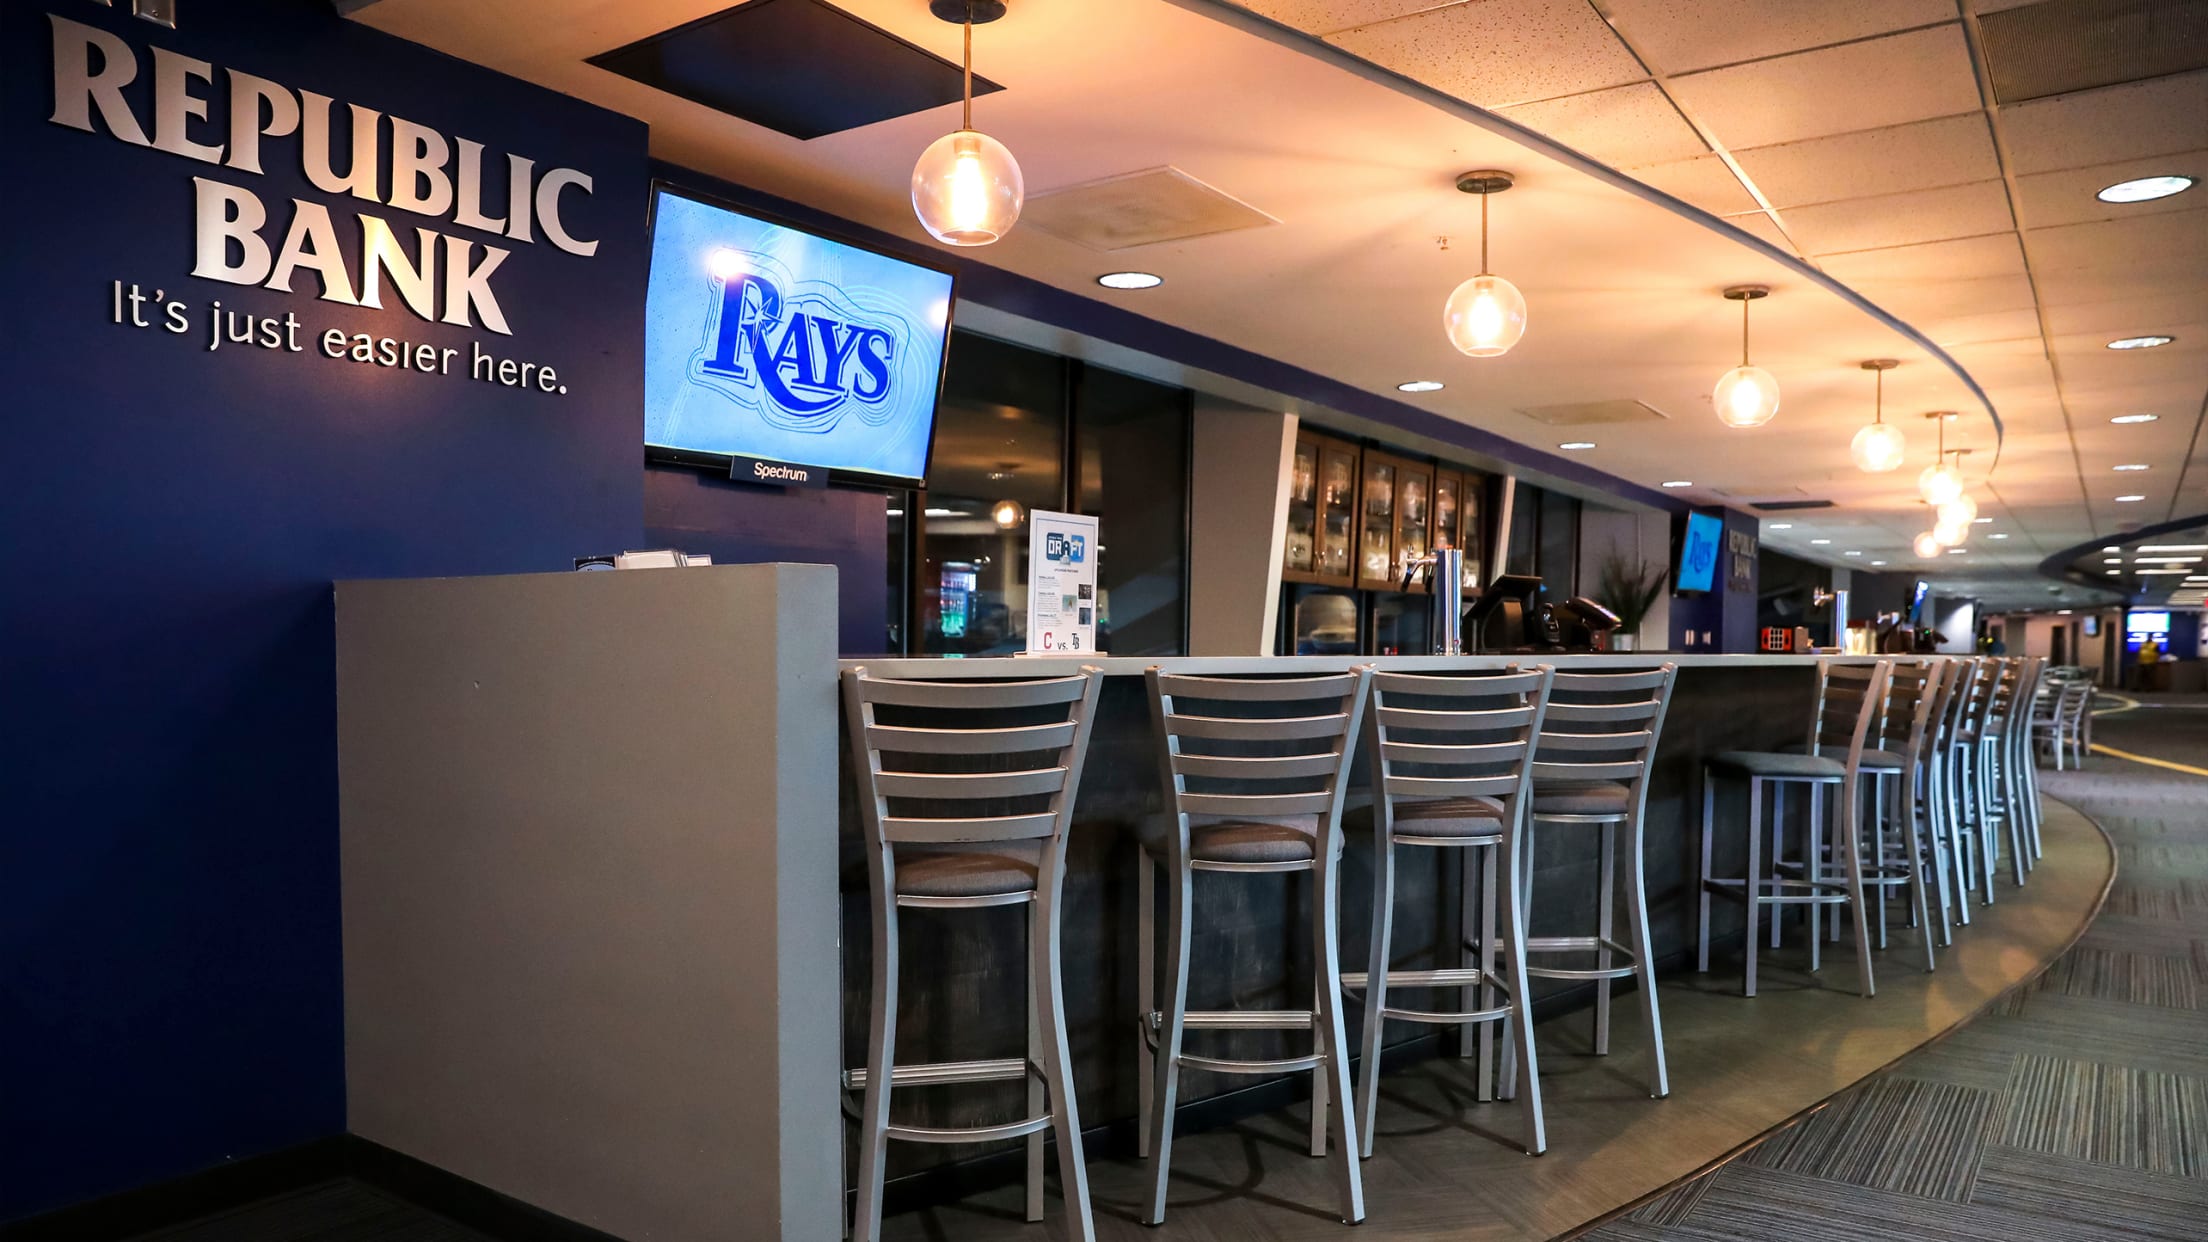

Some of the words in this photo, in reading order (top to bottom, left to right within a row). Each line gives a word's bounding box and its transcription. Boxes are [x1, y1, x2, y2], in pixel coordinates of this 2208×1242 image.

[46, 12, 600, 257] REPUBLIC
[189, 175, 513, 336] BANK
[112, 280, 189, 334] It's
[209, 300, 304, 352] just
[472, 340, 568, 395] here.
[703, 271, 894, 417] RAYS
[753, 461, 808, 482] Spectrum
[1048, 539, 1084, 557] DRAFT
[1043, 631, 1052, 649] C
